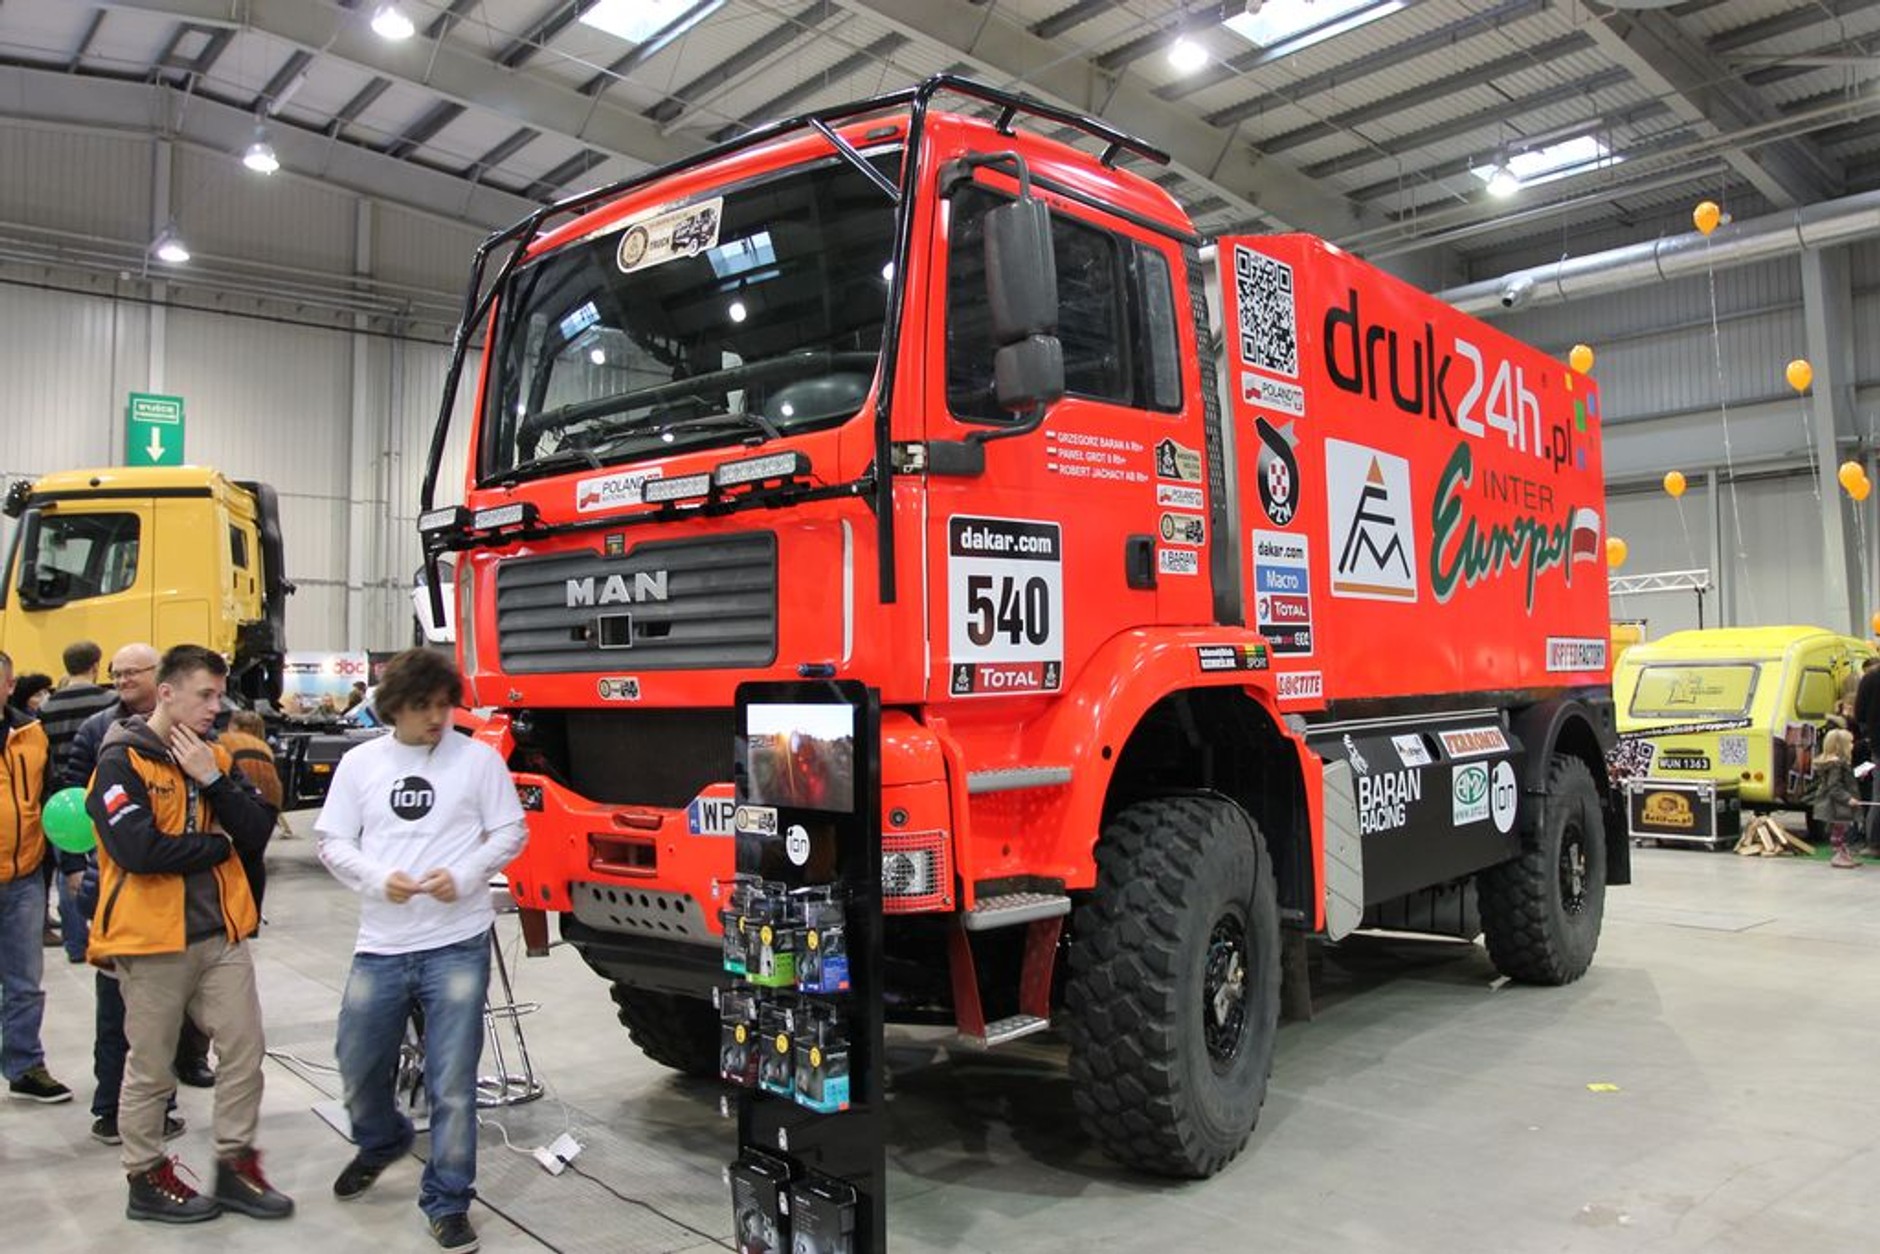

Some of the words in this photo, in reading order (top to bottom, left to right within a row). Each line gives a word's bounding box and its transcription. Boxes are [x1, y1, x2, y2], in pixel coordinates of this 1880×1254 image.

[1483, 471, 1554, 513] INTER
[960, 526, 1052, 553] dakar.com
[1258, 541, 1304, 559] dakar.com
[566, 570, 668, 607] MAN
[1266, 570, 1299, 589] Macro
[967, 575, 1049, 646] 540
[980, 668, 1038, 688] TOTAL
[1277, 675, 1320, 695] LOCTITE
[1683, 759, 1710, 769] 1363
[393, 780, 433, 808] ion
[1359, 768, 1421, 812] BARAN
[703, 803, 735, 831] WP
[1360, 803, 1406, 835] RACING
